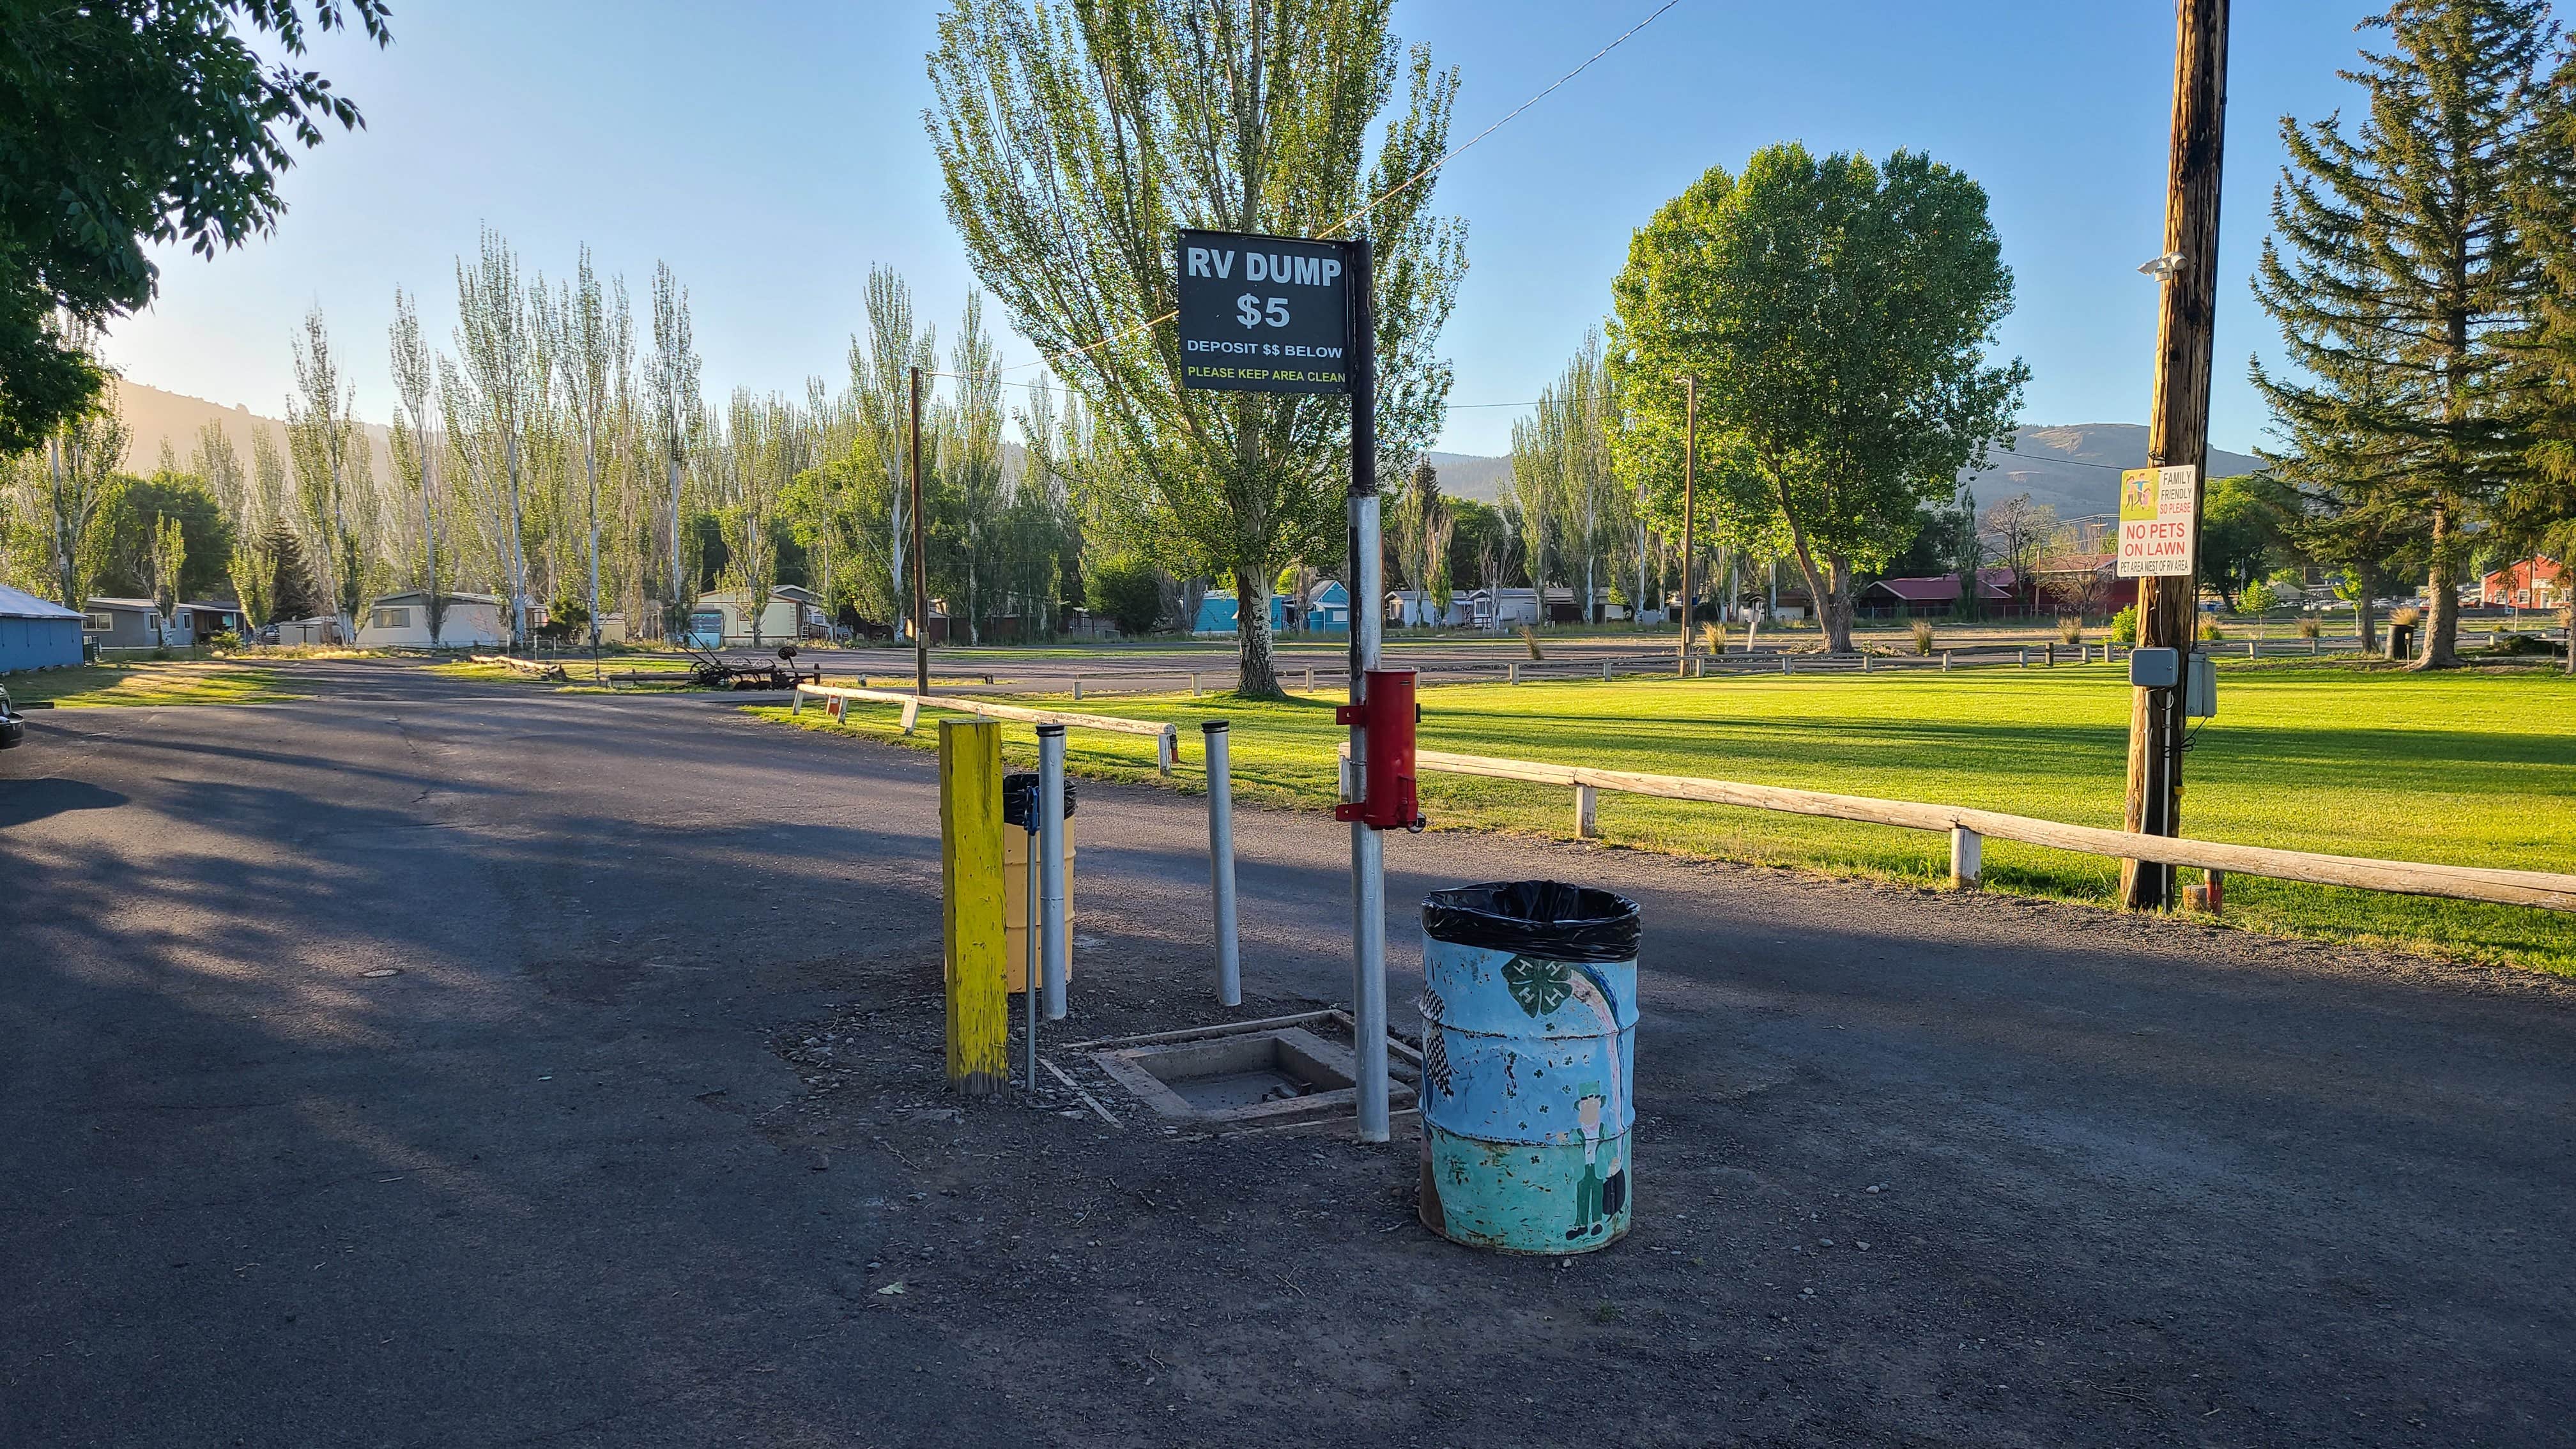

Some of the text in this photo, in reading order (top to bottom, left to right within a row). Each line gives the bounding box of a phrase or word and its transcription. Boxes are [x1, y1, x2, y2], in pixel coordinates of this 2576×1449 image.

[1188, 247, 1341, 286] RV DUMP
[1237, 293, 1290, 329] $5
[1188, 340, 1342, 358] DEPOSIT $$ BELOW
[1188, 366, 1346, 383] PLEASE KEEP AREA CLEAN
[2163, 471, 2191, 486] FAMILY
[2161, 488, 2192, 500] FRIENDLY
[2160, 503, 2191, 514] SO PLEASE
[2126, 523, 2185, 540] NO PETS
[2125, 541, 2184, 556] ON LAWN
[2121, 560, 2188, 572] PET AREA WEST OF RV AREA
